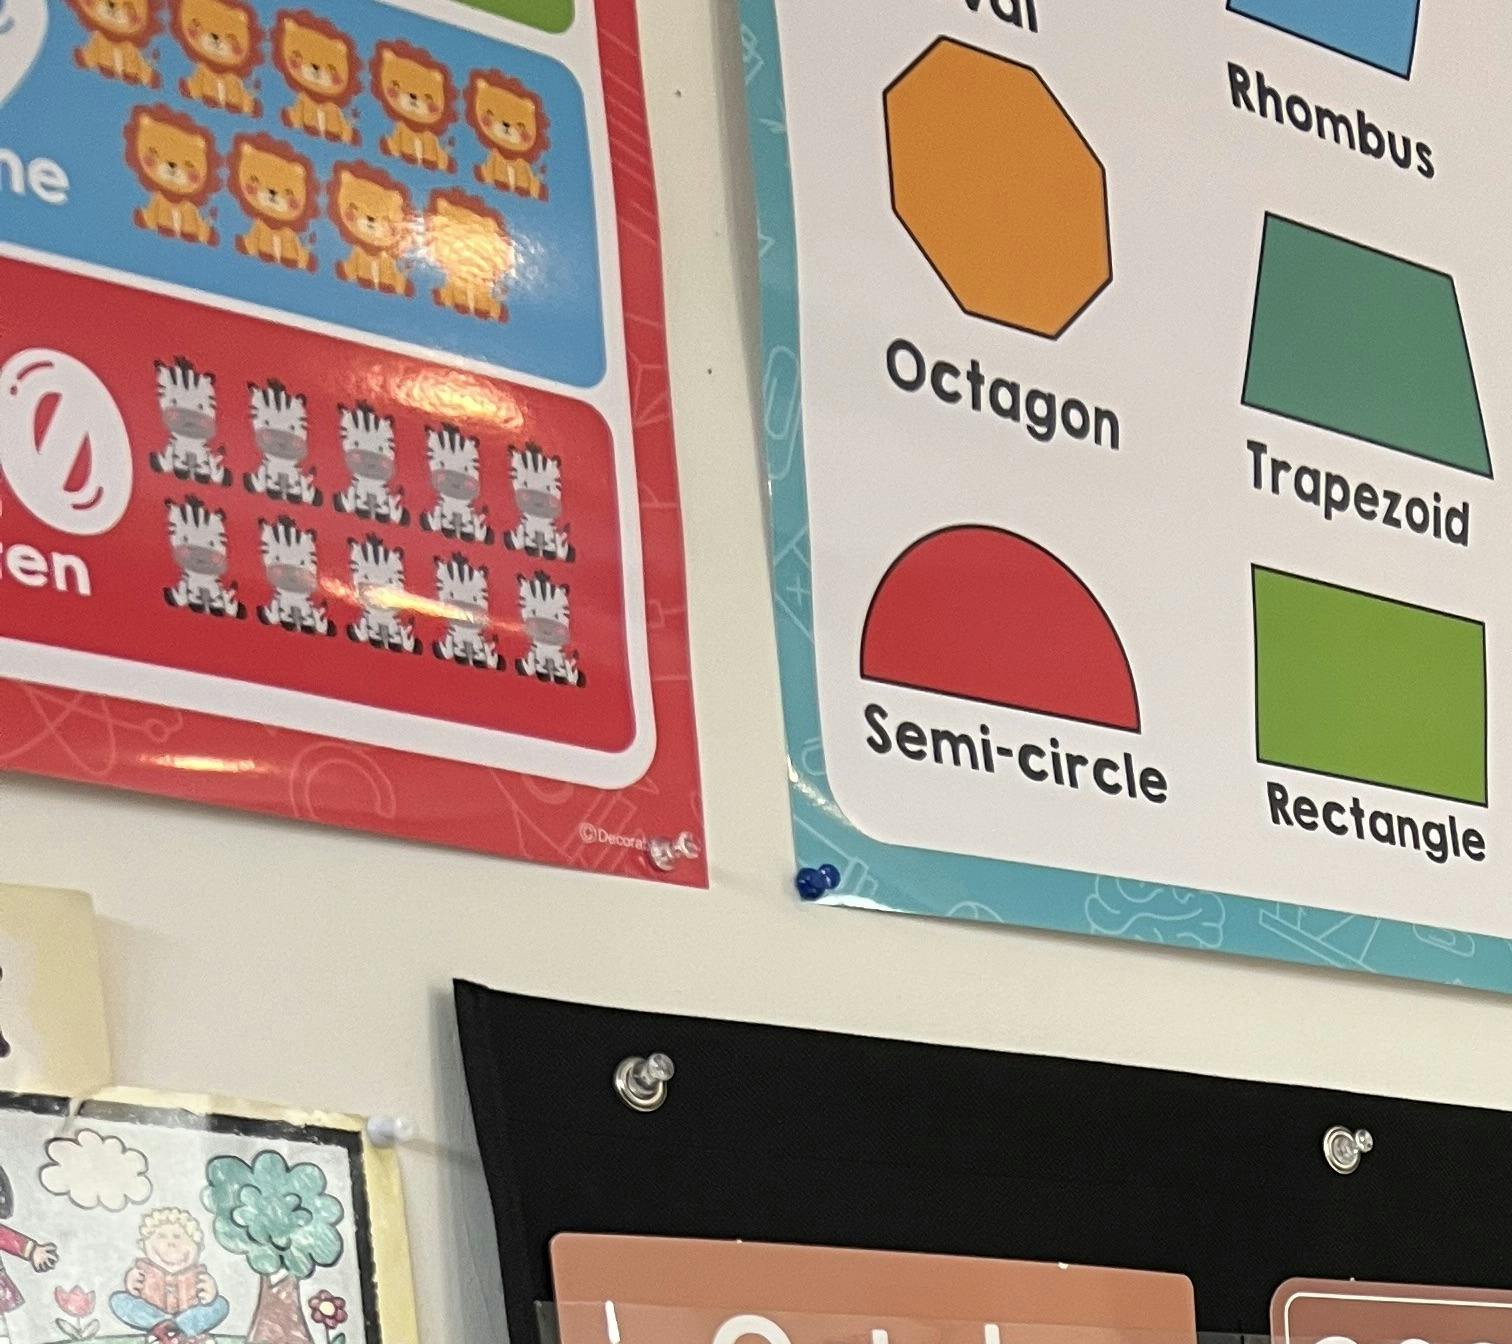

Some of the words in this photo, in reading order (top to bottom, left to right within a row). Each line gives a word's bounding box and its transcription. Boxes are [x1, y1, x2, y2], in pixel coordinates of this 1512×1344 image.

[1227, 61, 1435, 179] Rhombus
[886, 338, 1120, 450] Octagon
[1246, 439, 1470, 548] Trapezoid
[864, 703, 1168, 804] Semi-circle
[1266, 781, 1486, 864] Rectangle
